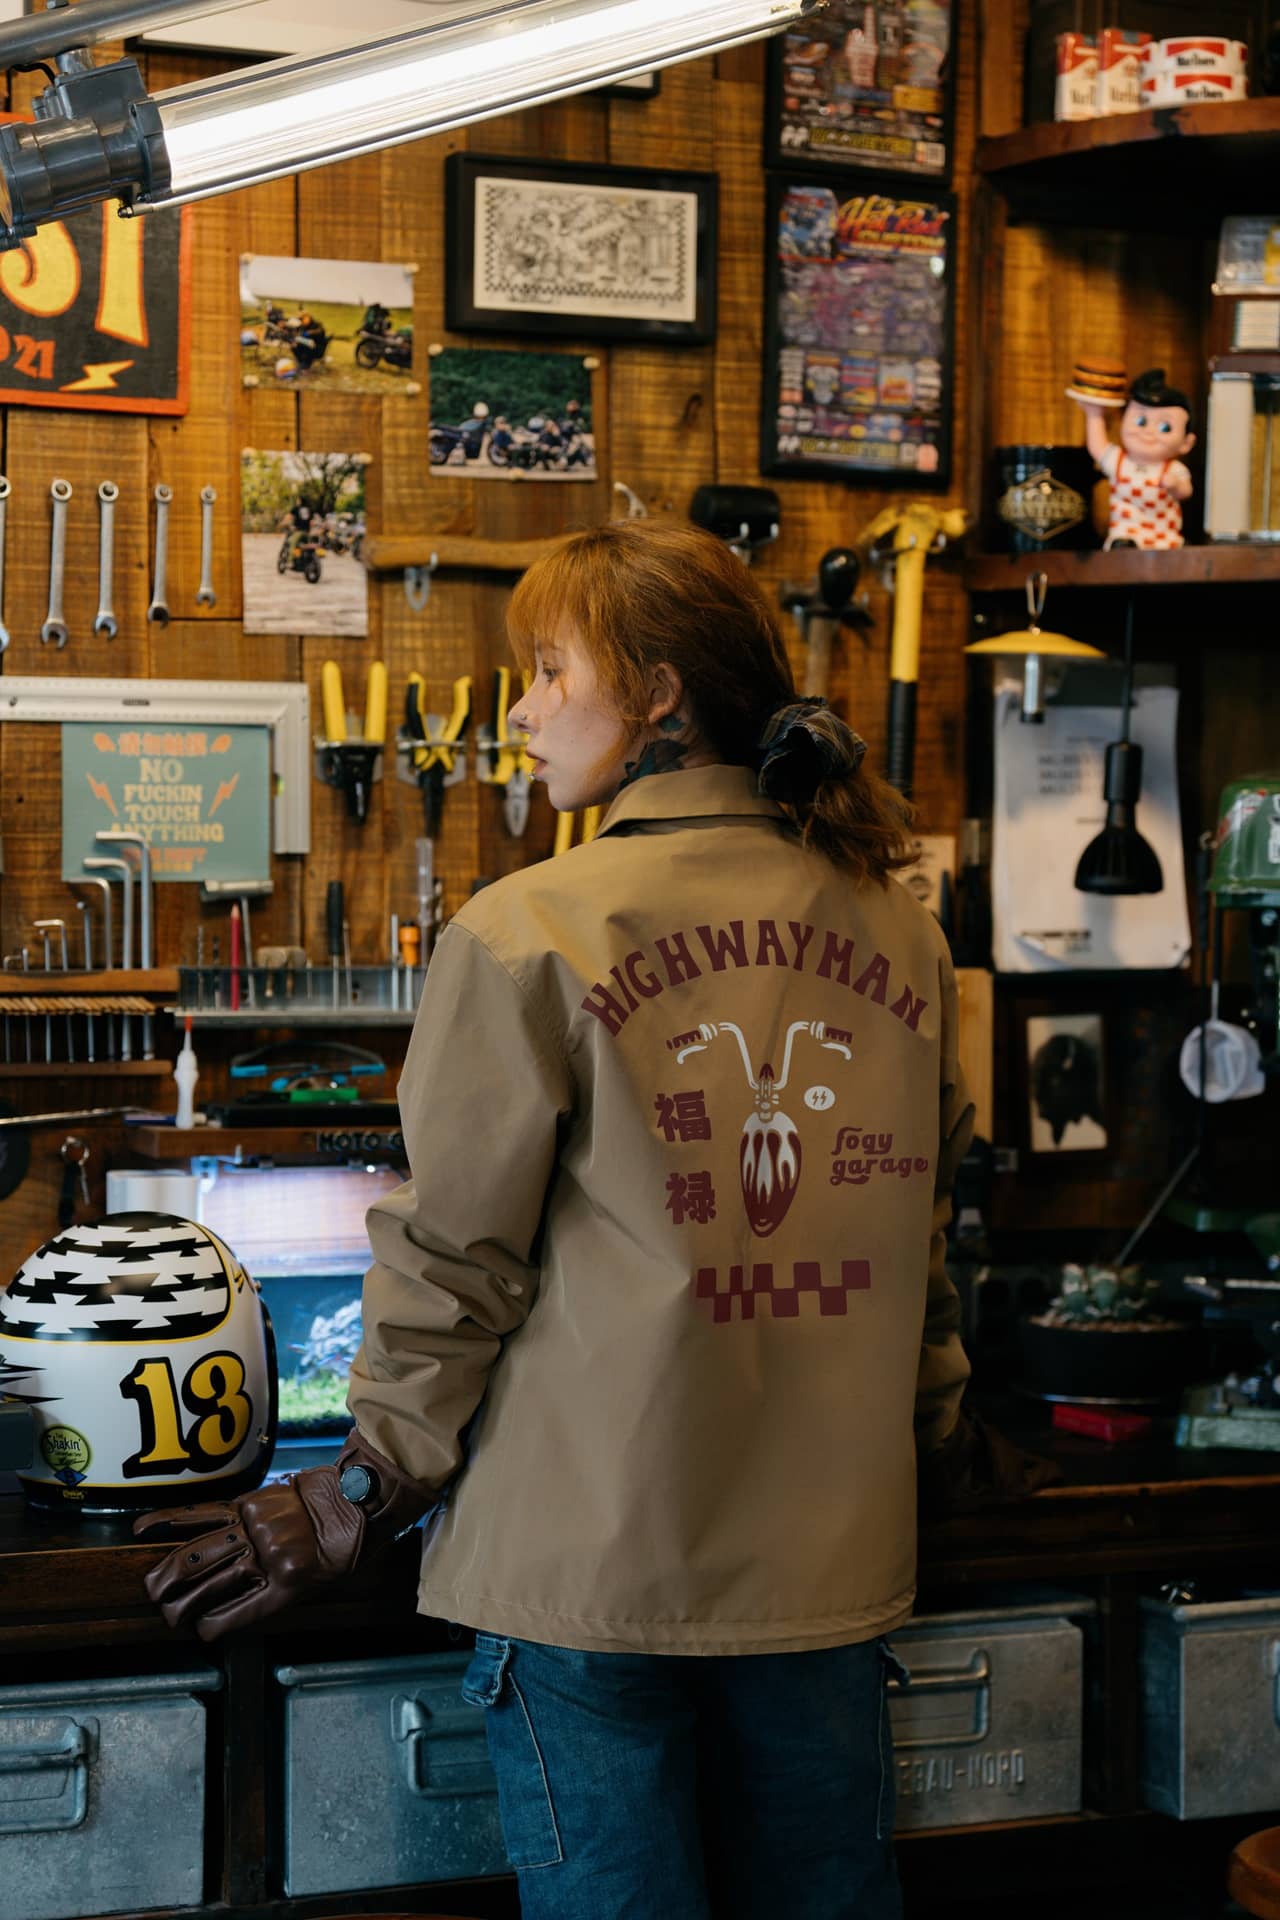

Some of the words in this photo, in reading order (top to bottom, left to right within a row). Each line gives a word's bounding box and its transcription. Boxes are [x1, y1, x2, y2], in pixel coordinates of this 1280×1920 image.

[140, 758, 184, 783] NO
[123, 784, 203, 803] FUCKIN
[124, 804, 201, 822] TOUCH
[580, 919, 929, 1036] HIGHWAYMAN
[317, 1132, 380, 1153] MOTO
[830, 1156, 929, 1186] garage
[46, 1434, 82, 1453] Shakin'
